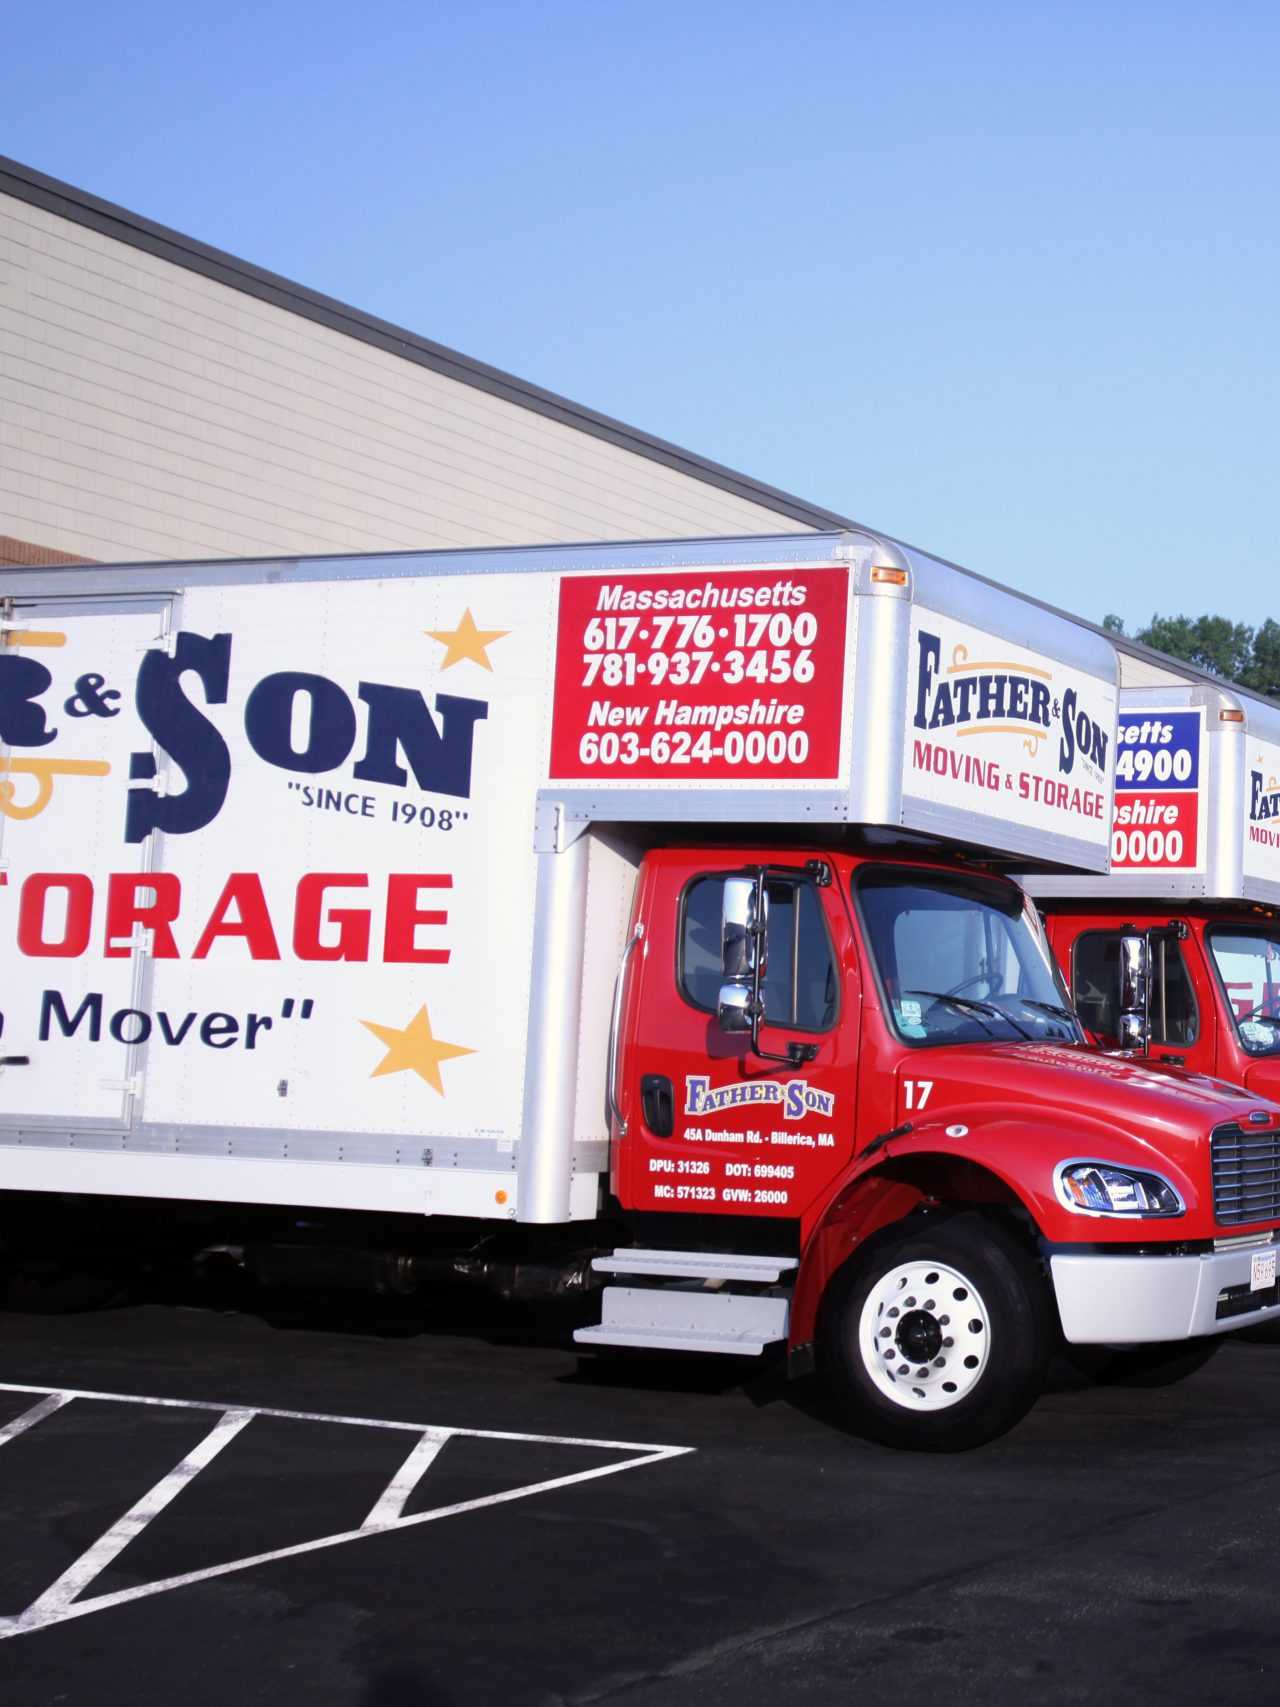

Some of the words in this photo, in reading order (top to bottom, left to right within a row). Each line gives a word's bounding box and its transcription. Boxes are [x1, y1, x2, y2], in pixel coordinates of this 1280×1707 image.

[596, 581, 807, 611] Massachusetts
[587, 701, 649, 726] New
[654, 699, 804, 731] Hampshire
[913, 629, 1051, 730] FATHER
[1051, 697, 1061, 719] &
[1059, 687, 1109, 775] SON
[64, 673, 121, 718] &
[124, 631, 489, 843] SON
[579, 731, 809, 764] 603-624-0000
[913, 739, 1000, 792] MOVING
[1005, 774, 1013, 790] &
[1019, 772, 1105, 820] STORAGE
[1116, 749, 1192, 781] 4900
[1112, 800, 1179, 825] shire
[1111, 830, 1184, 862] 0000
[0, 872, 454, 965] ORAGE
[38, 990, 314, 1050] Mover"
[687, 1078, 780, 1113] FATHER
[786, 1081, 832, 1118] SON
[903, 1081, 933, 1110] 17
[705, 1129, 744, 1143] Dunham
[746, 1131, 763, 1144] Rd.
[771, 1132, 816, 1149] Billerica,
[818, 1134, 834, 1147] MA
[649, 1159, 675, 1173] DPU:
[677, 1160, 710, 1174] 31326
[725, 1163, 751, 1177] DOT:
[754, 1164, 794, 1179] 699405
[654, 1185, 674, 1199] MC:
[677, 1186, 716, 1200] 571323
[723, 1189, 751, 1202] GVW:
[754, 1190, 788, 1204] 26000
